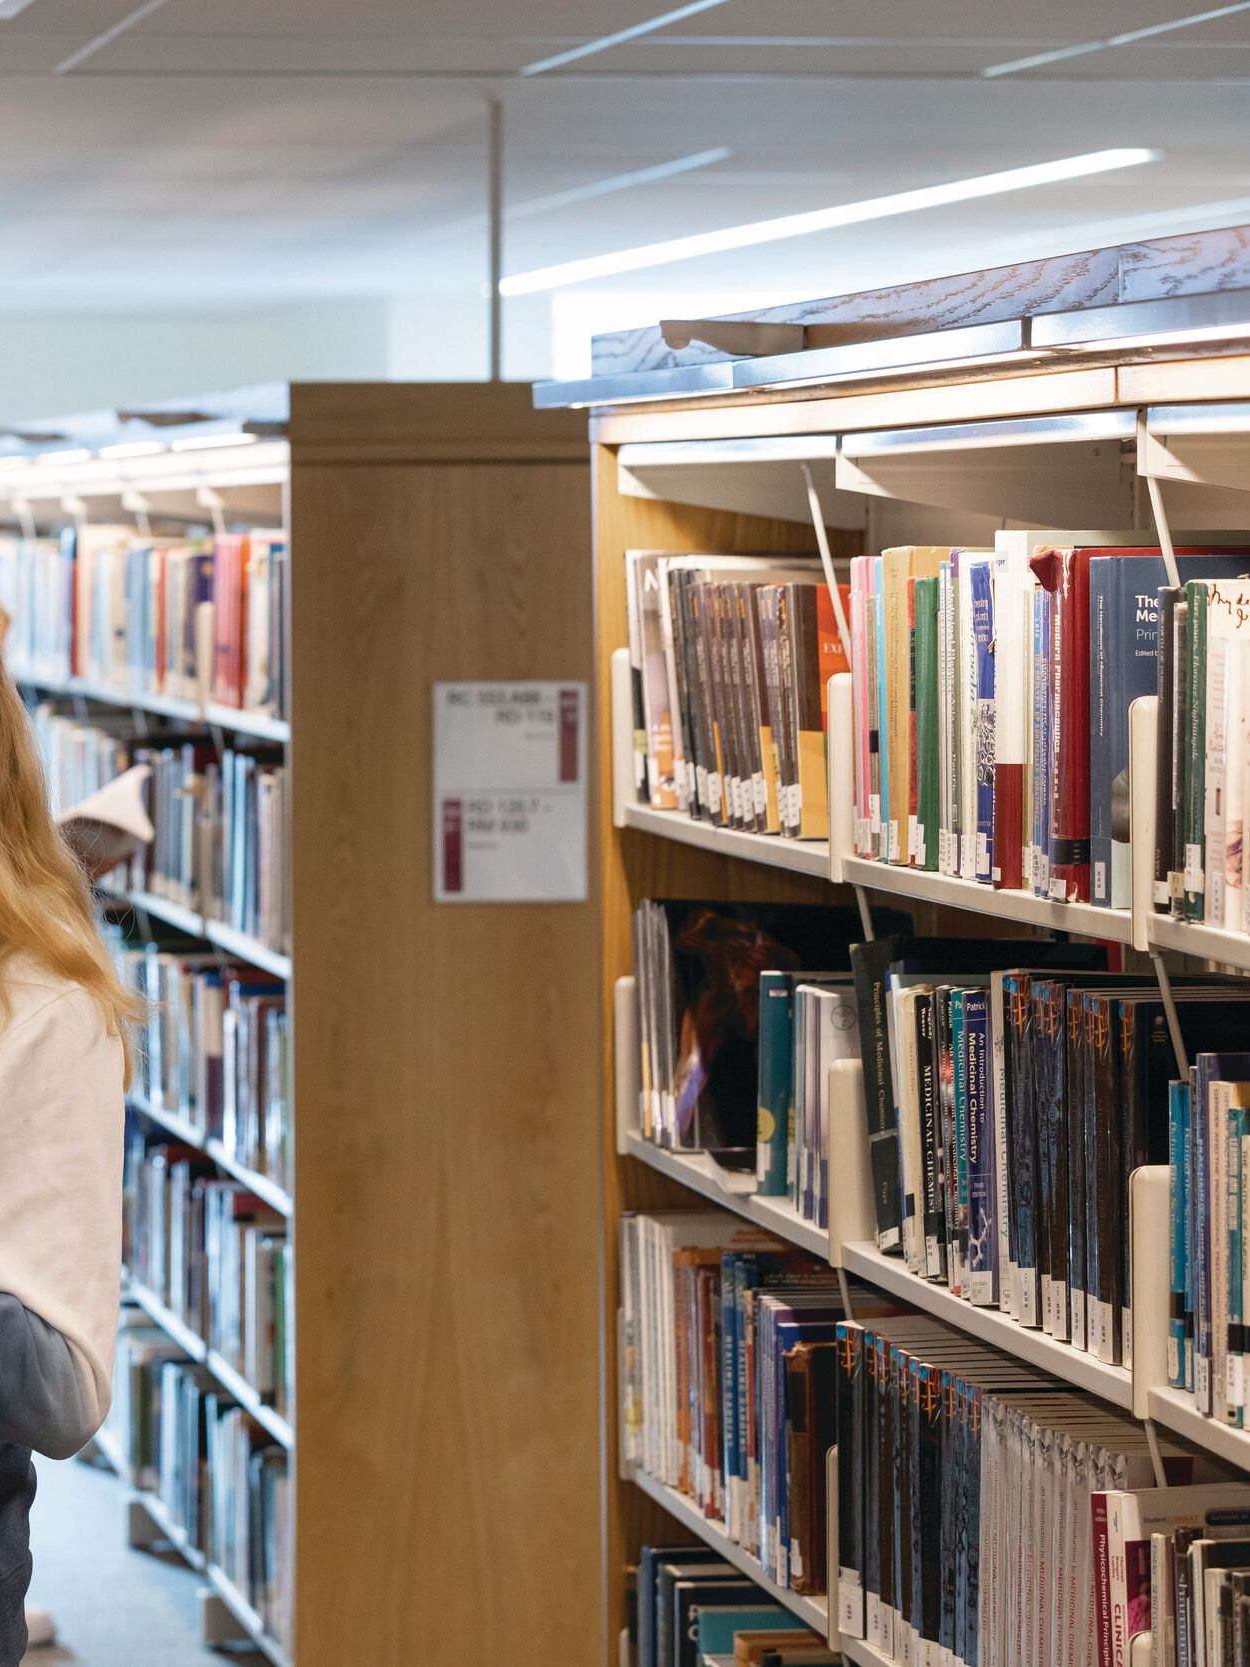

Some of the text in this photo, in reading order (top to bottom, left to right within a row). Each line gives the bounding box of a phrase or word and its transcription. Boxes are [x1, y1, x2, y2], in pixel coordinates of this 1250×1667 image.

[1054, 614, 1062, 661] Modern
[1192, 655, 1200, 697] Florence
[1191, 699, 1200, 761] Nightingale
[873, 981, 884, 1025] Principles
[966, 1001, 987, 1012] Patrick
[876, 1028, 884, 1038] of
[949, 1043, 955, 1057] An
[979, 1032, 986, 1046] An
[876, 1041, 886, 1085] Medicinal
[924, 1064, 934, 1147] MEDICINAL
[957, 1029, 969, 1161] Medicinal Chemistry
[968, 1032, 979, 1164] Medicinal Chemistry
[980, 1113, 986, 1123] to
[1000, 1067, 1011, 1238] Medicinal Chemistry
[1040, 1486, 1046, 1497] an
[1073, 1500, 1078, 1511] an
[1040, 1499, 1048, 1547] introduction
[1071, 1513, 1079, 1563] introduction
[1142, 1516, 1167, 1524] Student
[1040, 1550, 1046, 1559] to
[1071, 1565, 1078, 1574] to
[1100, 1534, 1110, 1619] Physicochemical
[1069, 1576, 1077, 1630] MEDICINAL
[1088, 1585, 1096, 1641] MEDICINAL
